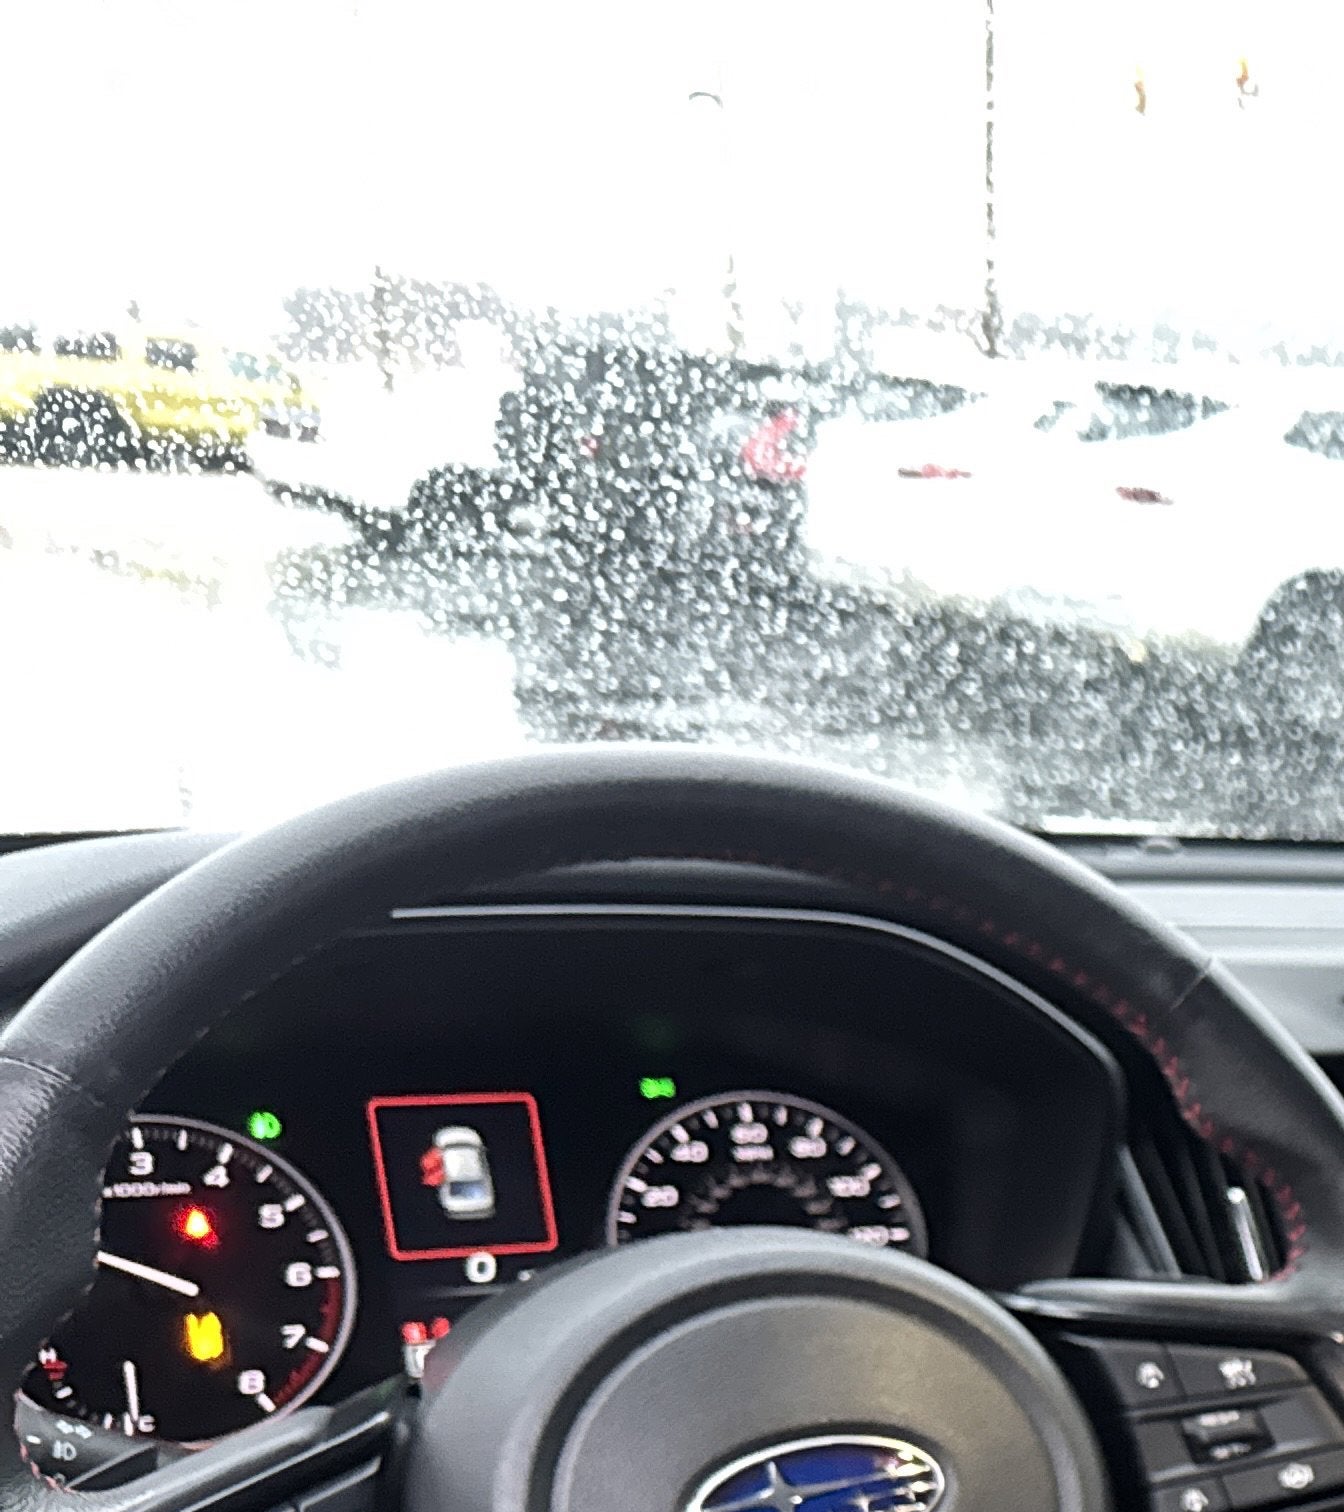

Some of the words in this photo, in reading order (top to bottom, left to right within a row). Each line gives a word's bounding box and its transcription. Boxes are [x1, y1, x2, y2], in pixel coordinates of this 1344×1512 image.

[128, 1151, 155, 1176] 3
[203, 1165, 230, 1188] 4
[258, 1203, 285, 1229] 5
[285, 1261, 312, 1287] 6
[281, 1325, 307, 1348] 7
[238, 1369, 266, 1395] 8
